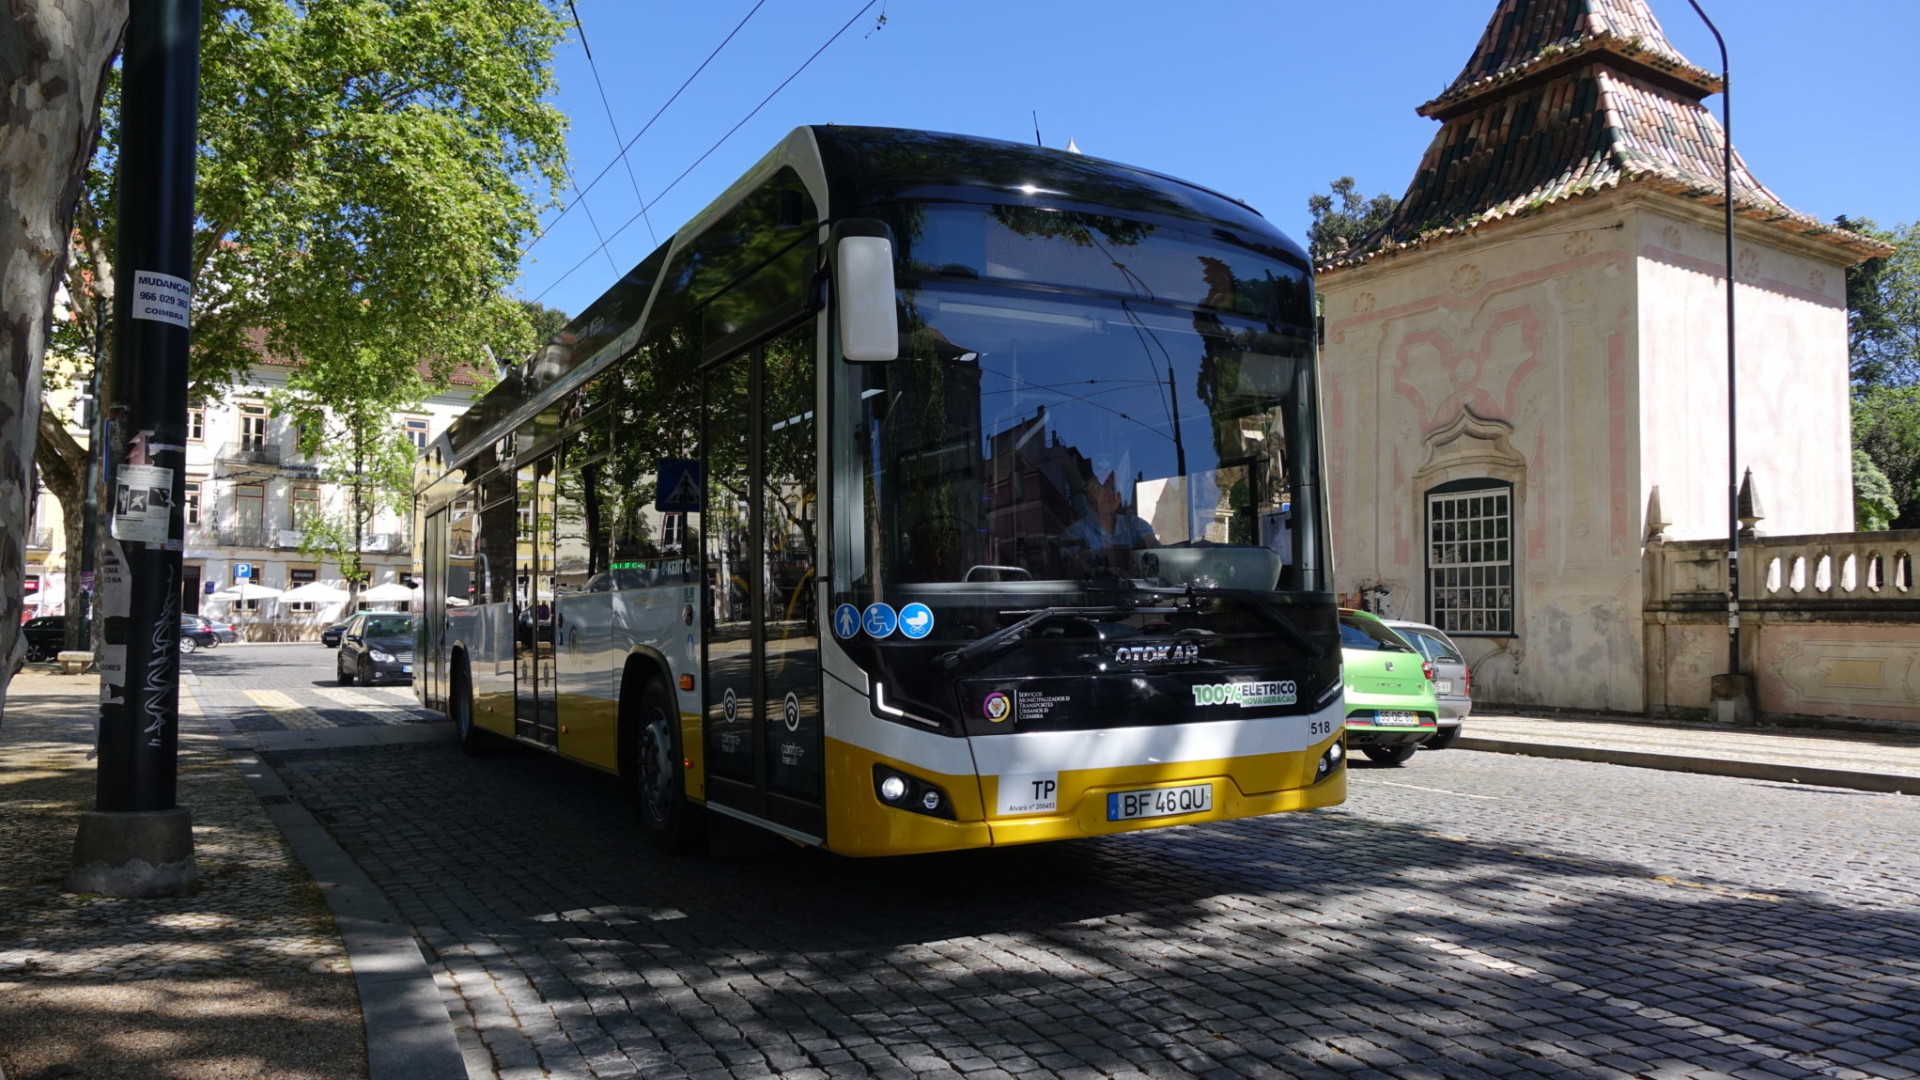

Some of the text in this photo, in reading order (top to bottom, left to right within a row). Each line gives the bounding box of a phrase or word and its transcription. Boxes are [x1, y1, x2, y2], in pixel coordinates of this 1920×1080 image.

[138, 276, 189, 294] MUDANÇAS
[140, 291, 156, 302] 966
[160, 294, 176, 304] 029
[145, 308, 184, 320] COIMBRA
[238, 564, 248, 576] P
[1116, 645, 1198, 665] OTOKAR
[1194, 685, 1242, 703] 100%
[1311, 722, 1330, 734] 518
[1032, 780, 1056, 800] TP
[1124, 788, 1204, 816] BF 46 QU
